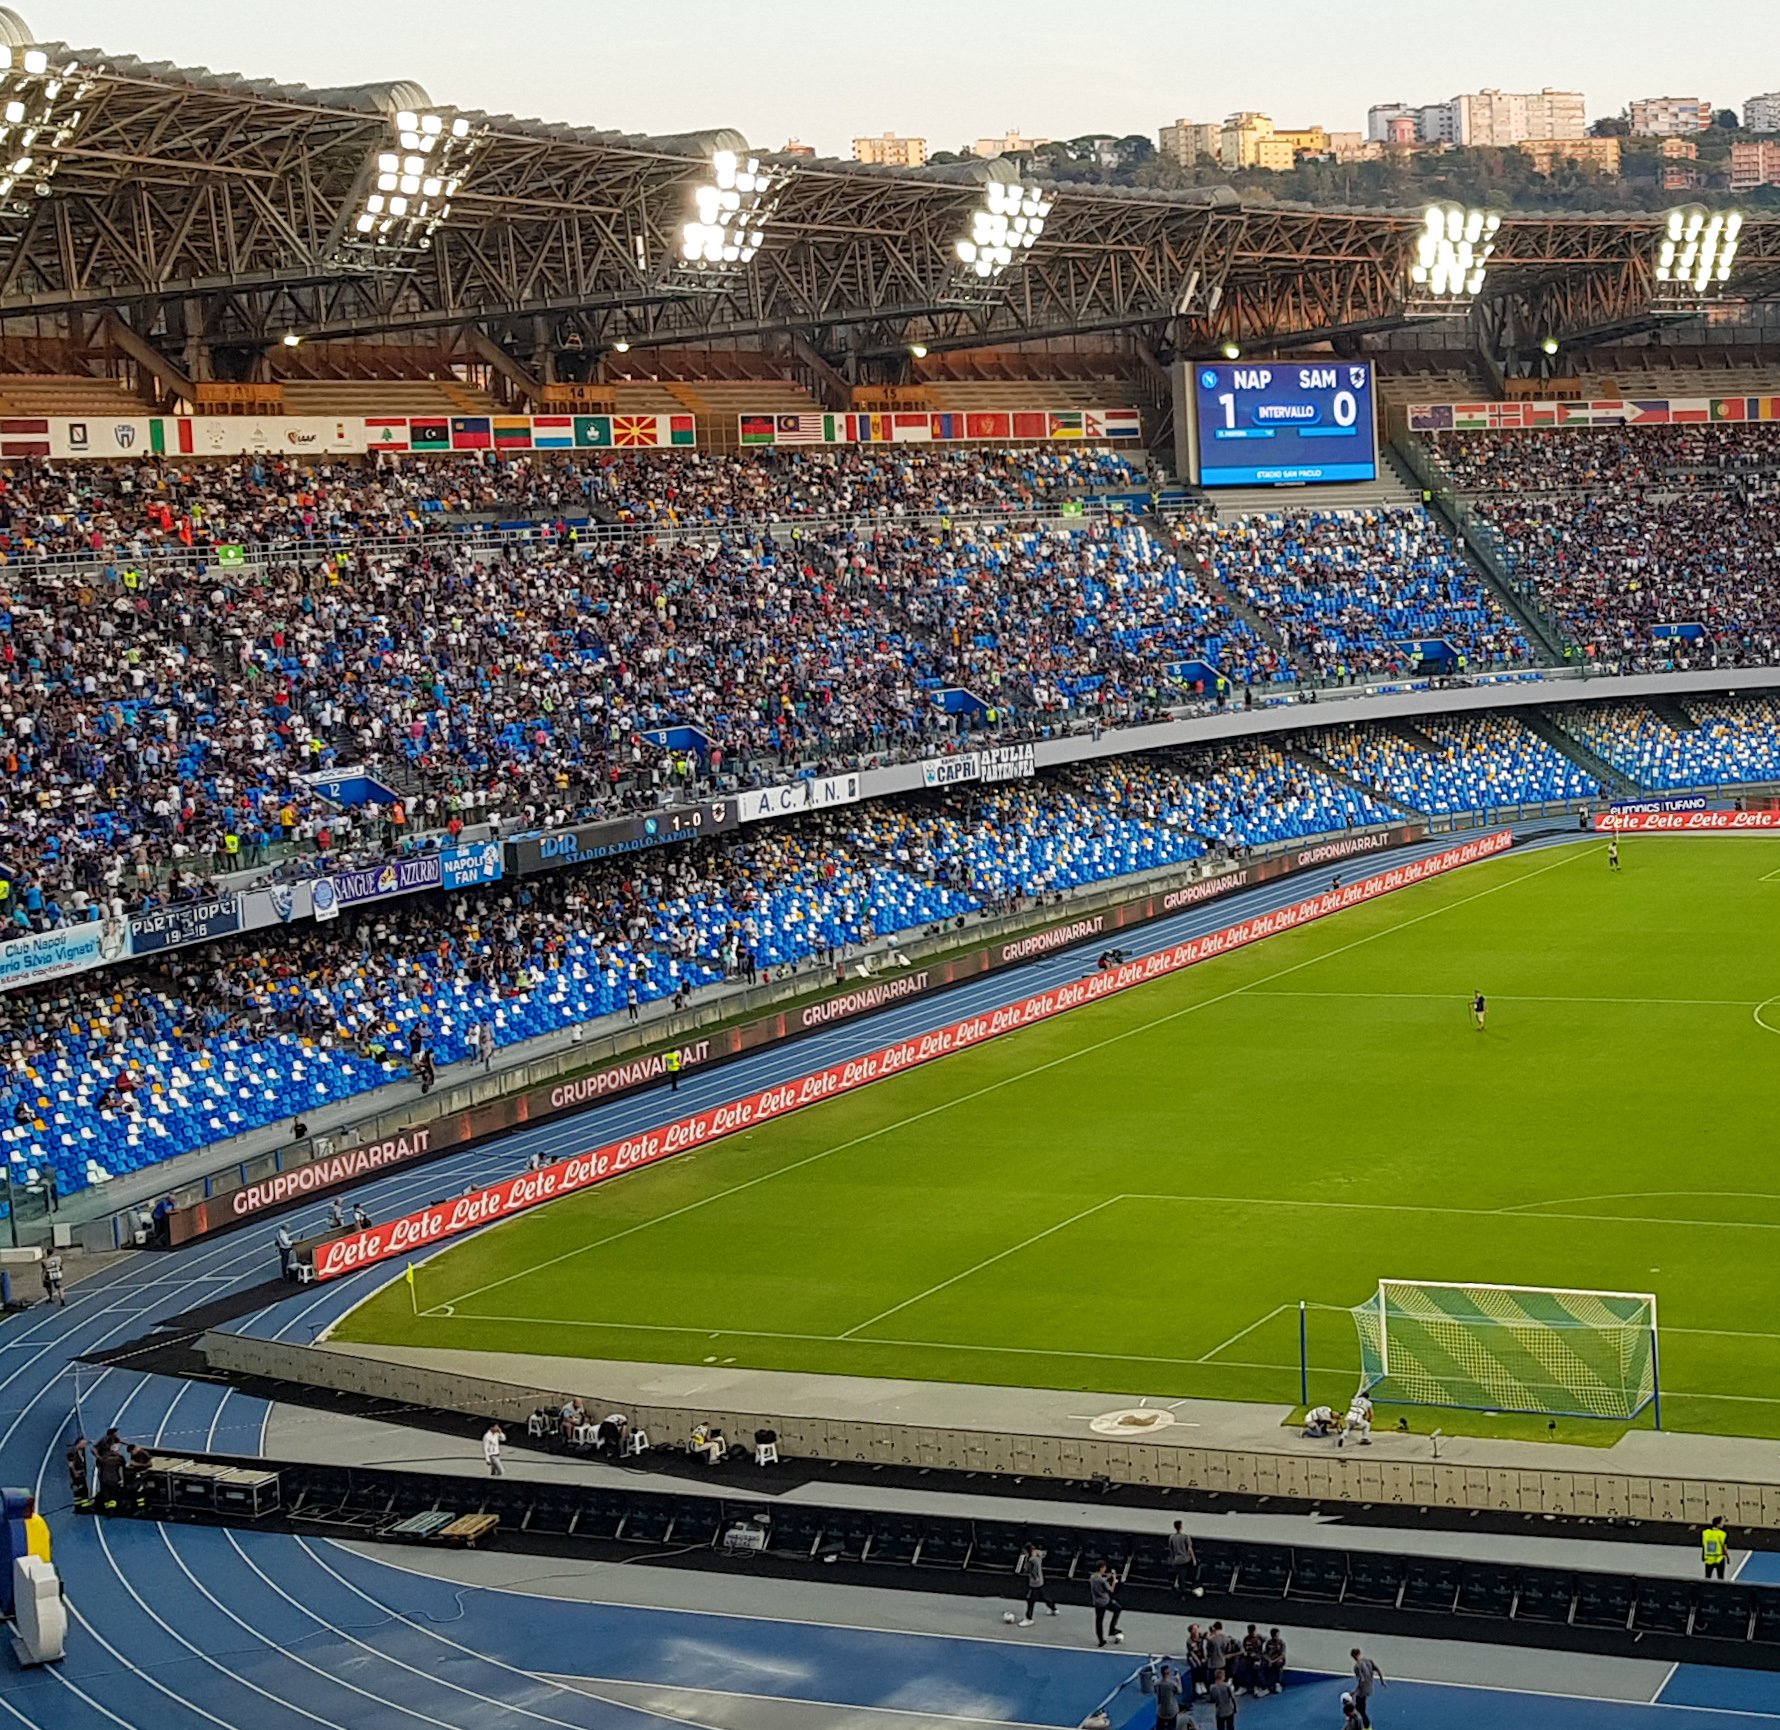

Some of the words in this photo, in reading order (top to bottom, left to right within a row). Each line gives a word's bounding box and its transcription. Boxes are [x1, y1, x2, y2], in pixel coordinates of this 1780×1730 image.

[1234, 370, 1272, 389] NAP
[1299, 369, 1337, 388] SAM
[569, 387, 584, 400] 14
[883, 389, 897, 400] 15
[1219, 393, 1236, 428] 1
[1258, 405, 1315, 418] INTERVALLO
[1333, 391, 1357, 427] 0
[1256, 470, 1281, 479] STADIO
[1282, 470, 1297, 479] SAN
[981, 743, 1034, 765] APULIA
[937, 760, 976, 782] CAPRI
[1665, 798, 1706, 811] TUFANO
[1597, 814, 1639, 829] Lete
[1641, 814, 1683, 829] Lete
[1685, 813, 1727, 828] Lete
[1729, 811, 1771, 827] Lete
[565, 847, 606, 863] STADIO
[1298, 832, 1389, 866] GRUPPONAVARRA.IT
[444, 857, 485, 873] NAPOLI
[455, 868, 478, 884] FAN
[335, 873, 376, 901] SANGUE
[400, 861, 439, 887] AZZURRO
[1164, 871, 1248, 910] GRUPPONAVARRA.IT
[132, 901, 237, 936] PARTOPEI
[5, 941, 29, 958] Club
[34, 932, 66, 951] Napoli
[1003, 915, 1104, 961] GRUPPONAVARRA.IT
[24, 954, 53, 968] Silvio
[803, 972, 929, 1027] GRUPPONAVARRA.IT
[319, 1232, 380, 1275] Lete
[384, 1212, 443, 1252] Lete
[445, 1192, 501, 1232] Lete
[503, 1172, 556, 1211] Lete
[558, 1152, 608, 1190] Lete
[610, 1135, 659, 1171] Lete
[663, 1119, 706, 1156] Lete
[708, 1101, 752, 1136] Lete
[754, 1086, 796, 1120] Lete
[798, 1070, 837, 1103] Lete
[838, 1055, 877, 1089] Lete
[878, 1043, 915, 1075] Lete
[915, 1030, 952, 1060] Lete
[952, 1017, 987, 1047] Lete
[989, 1006, 1021, 1034] Lete
[1021, 995, 1053, 1022] Lete
[1053, 984, 1085, 1011] Lete
[1085, 973, 1115, 999] Lete
[1115, 962, 1143, 988] Lete
[1143, 954, 1171, 979] Lete
[1171, 943, 1198, 968] Lete
[1198, 934, 1225, 958] Lete
[1225, 925, 1249, 949] Lete
[1250, 915, 1274, 939] Lete
[1274, 908, 1297, 931] Lete
[1298, 900, 1319, 922] Lete
[1320, 891, 1342, 914] Lete
[1342, 883, 1363, 906] Lete
[1363, 877, 1384, 899] Lete
[1384, 870, 1405, 891] Lete
[1405, 862, 1425, 883] Lete
[1424, 855, 1443, 876] Lete
[1442, 849, 1460, 869] Lete
[1460, 842, 1479, 863] Lete
[1478, 836, 1496, 856] Lete
[551, 1041, 710, 1108] GRUPPONAVAA.IT
[233, 1130, 431, 1214] GRUPPONAVARRA.IT
